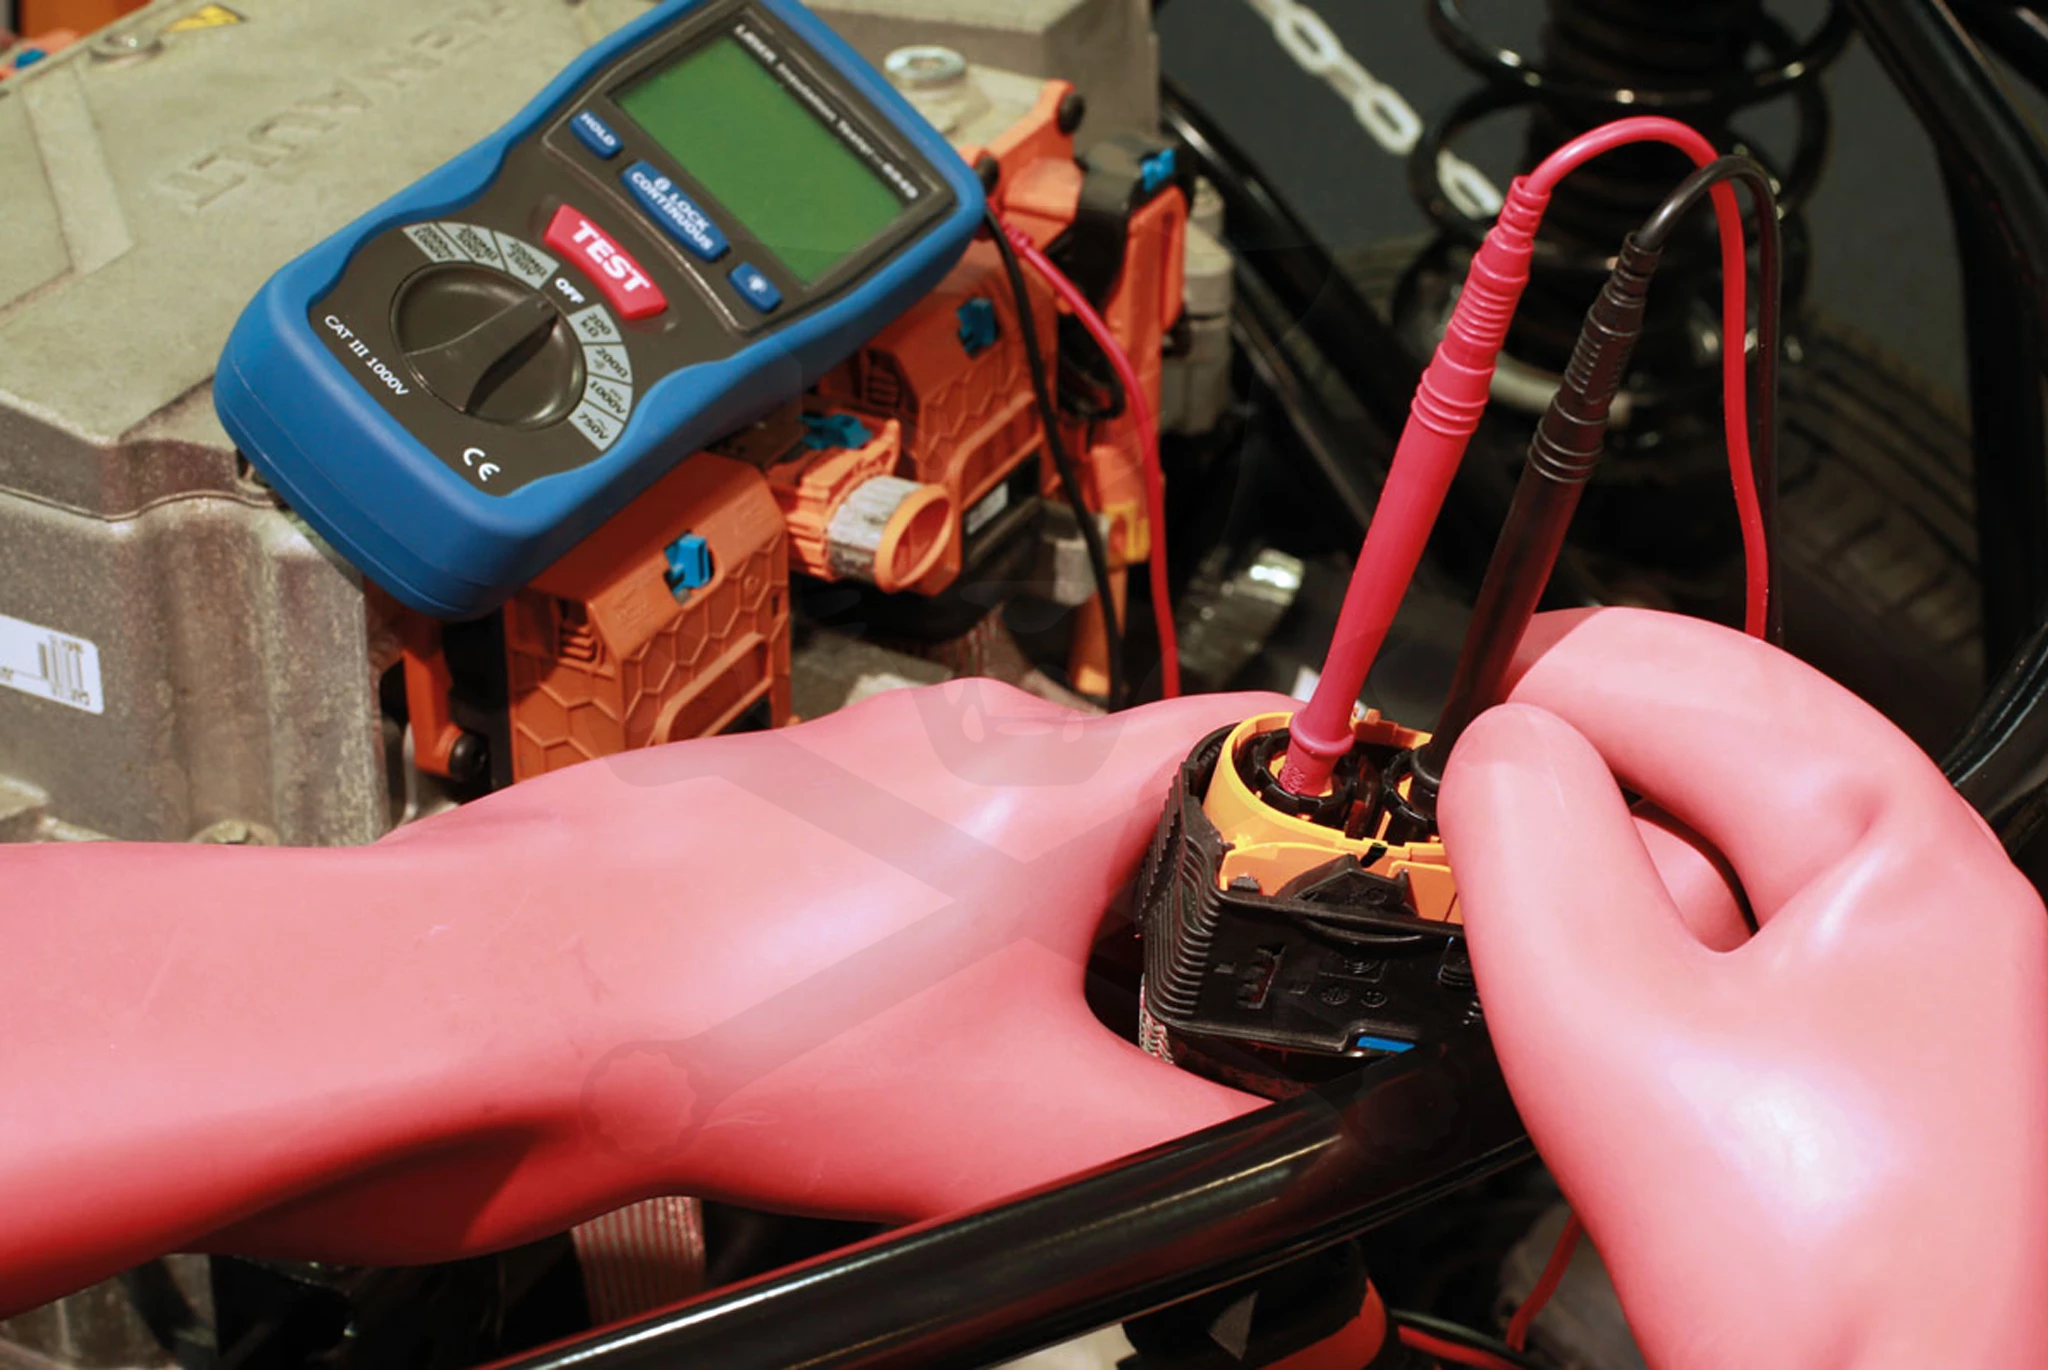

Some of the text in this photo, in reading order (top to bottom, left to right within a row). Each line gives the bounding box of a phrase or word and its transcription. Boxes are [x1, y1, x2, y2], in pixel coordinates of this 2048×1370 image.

[580, 112, 617, 147] HOLD
[631, 171, 714, 250] CONTINUOUS
[669, 193, 710, 233] LOCK
[572, 220, 651, 292] TEST
[555, 277, 586, 303] OFF
[587, 313, 612, 336] 200
[324, 314, 410, 396] CAT III 1000V
[589, 379, 627, 414] 1000V
[578, 411, 609, 440] 750V
